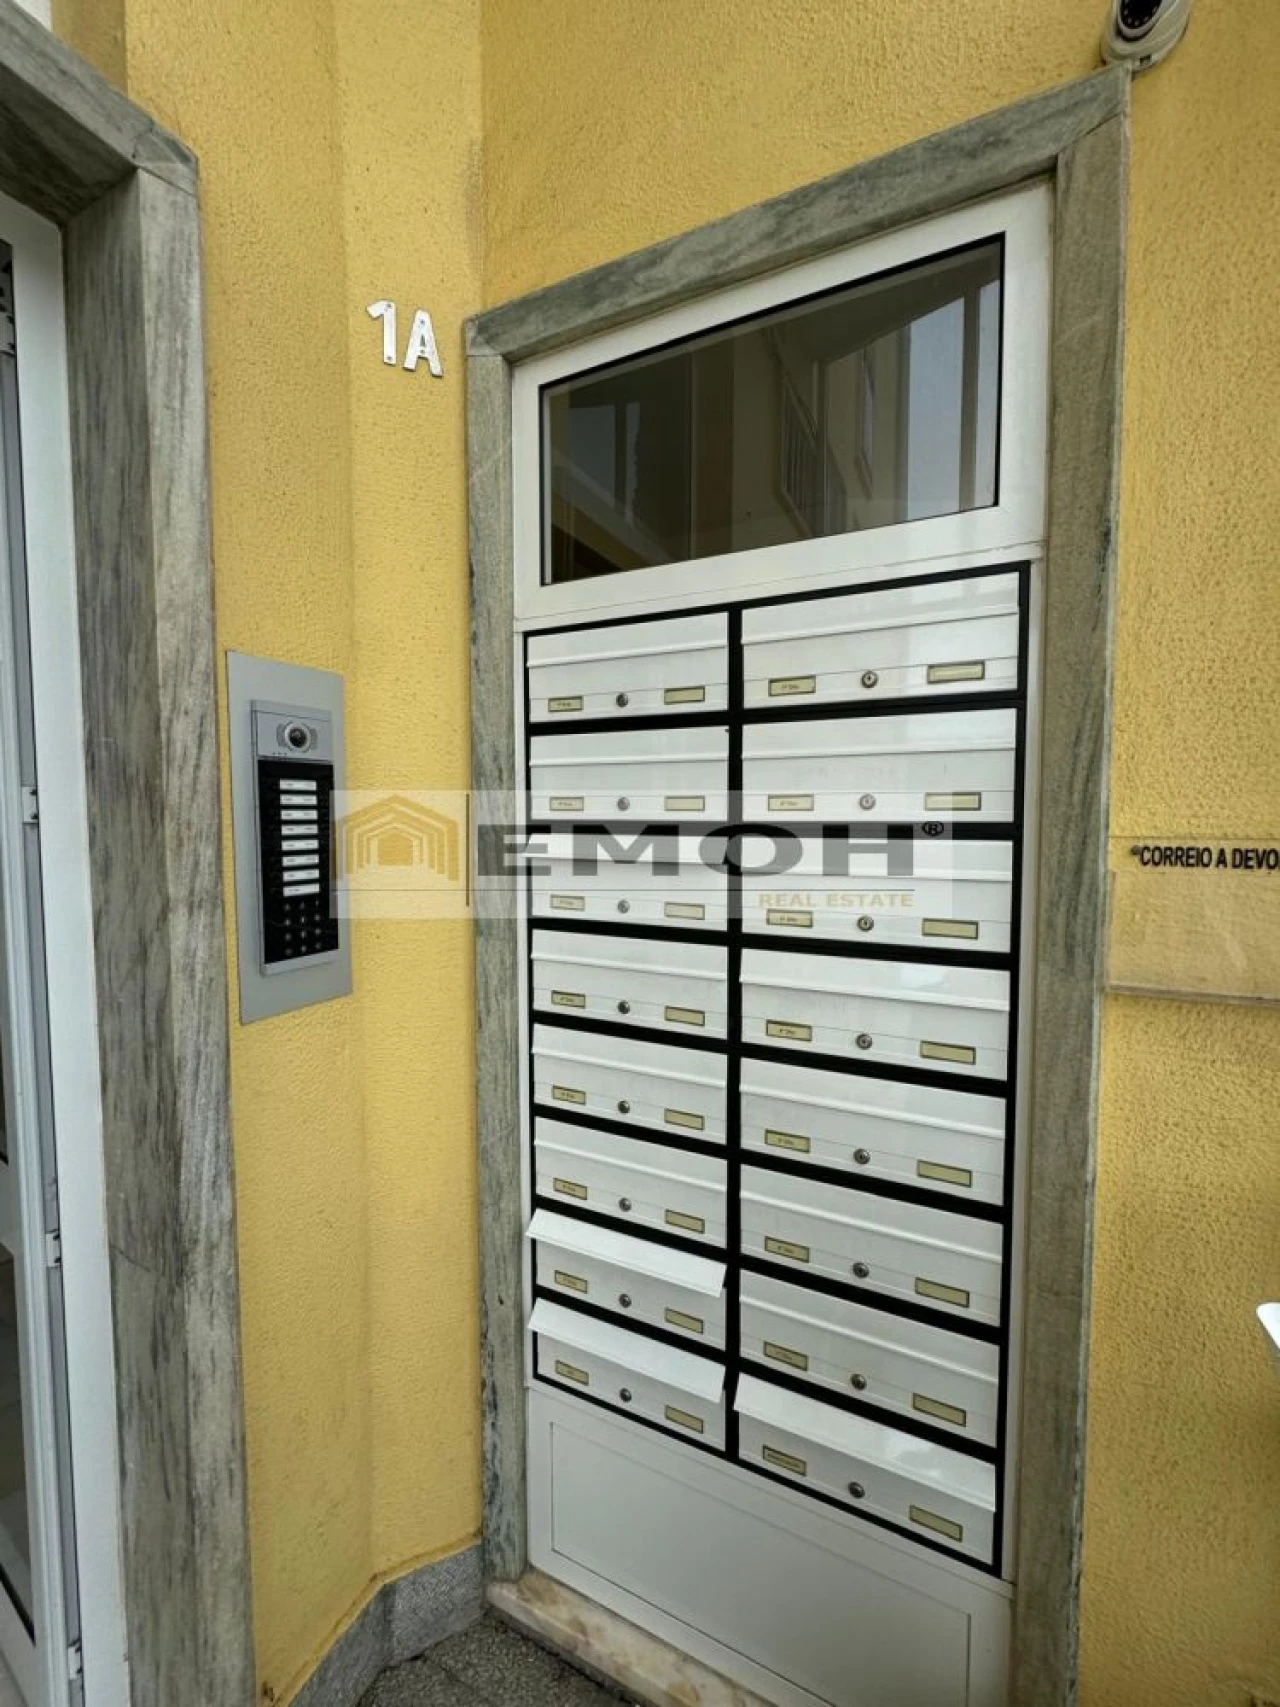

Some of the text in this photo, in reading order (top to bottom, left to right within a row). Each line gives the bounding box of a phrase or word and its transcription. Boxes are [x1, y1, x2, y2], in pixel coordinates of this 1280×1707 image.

[366, 300, 443, 379] 1A
[1140, 845, 1213, 867] CORREIO
[1215, 847, 1228, 868] A
